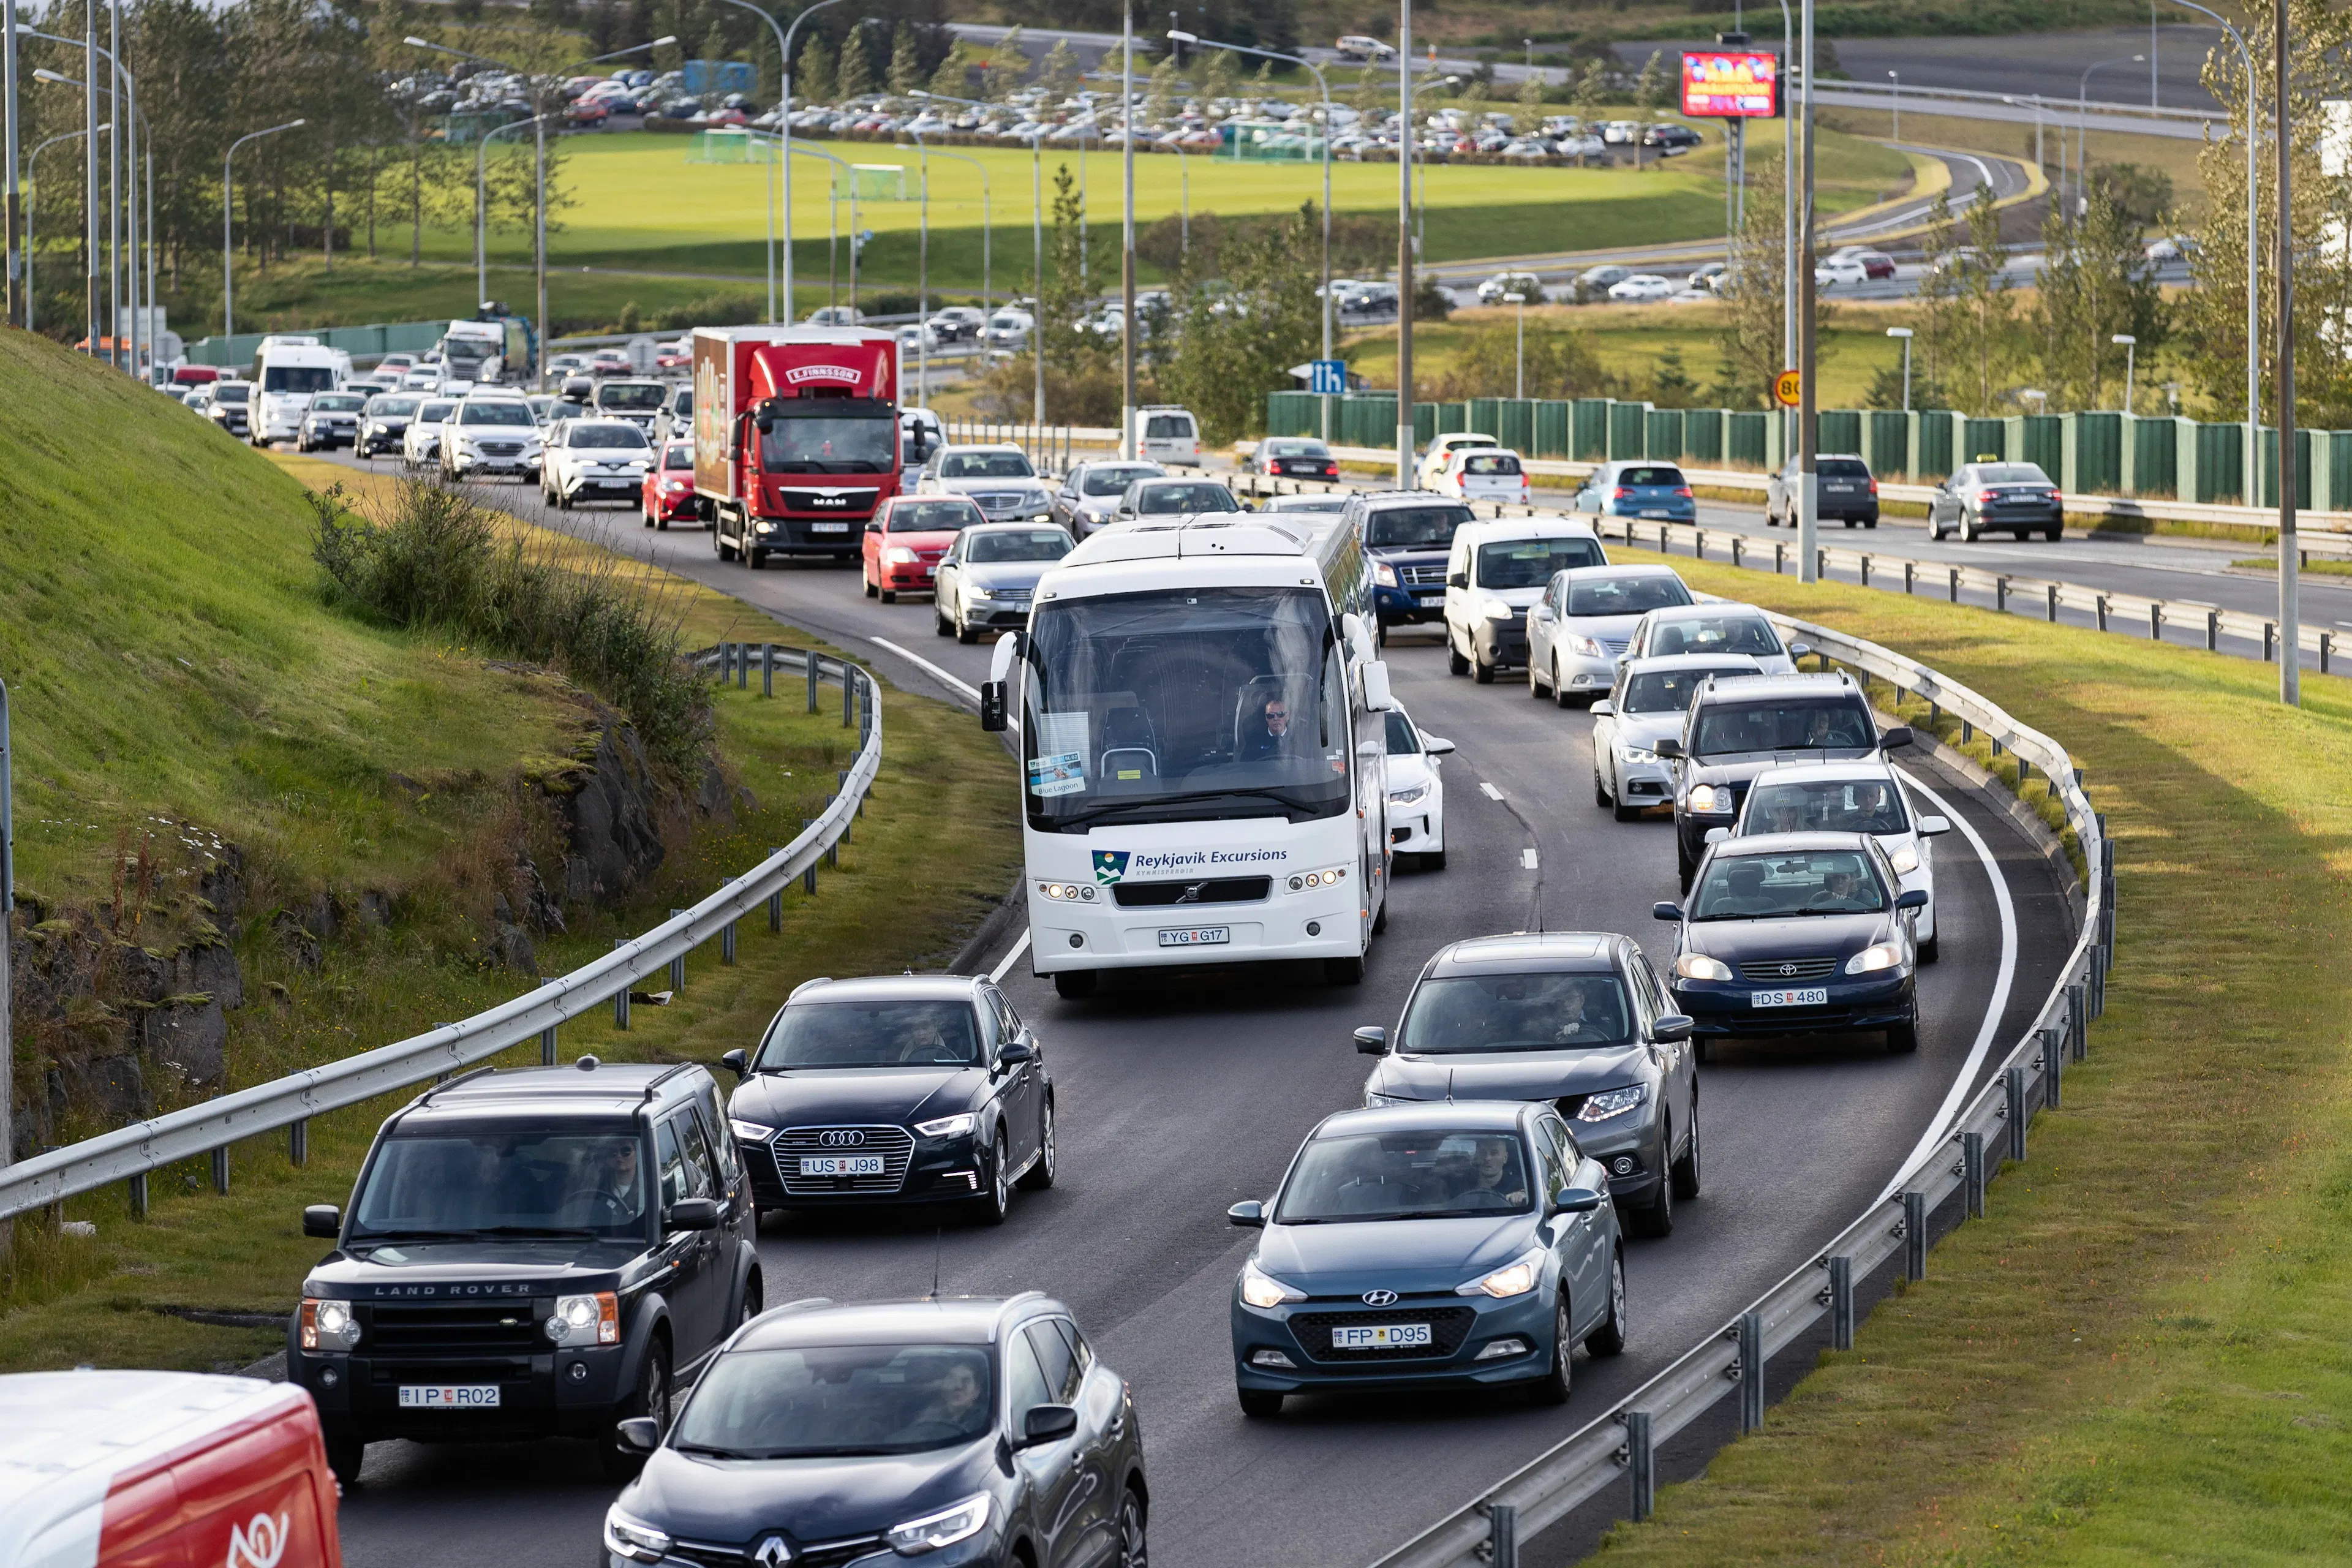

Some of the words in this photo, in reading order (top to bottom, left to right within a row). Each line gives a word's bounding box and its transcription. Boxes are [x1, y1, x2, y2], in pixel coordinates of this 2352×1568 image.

[1054, 783, 1078, 792] Lagoon
[1136, 852, 1206, 869] Reykjavik
[1210, 849, 1287, 862] Excursions
[1170, 932, 1189, 942] YG
[1200, 930, 1223, 941] G17
[1761, 993, 1784, 1005] DS
[1797, 990, 1825, 1003] 480
[813, 1159, 835, 1172] US
[850, 1159, 879, 1172] J98
[375, 1287, 435, 1295] LAND
[450, 1284, 529, 1294] ROVER
[1348, 1329, 1373, 1344] FP
[1390, 1327, 1427, 1343] D95
[415, 1389, 439, 1403] IP
[458, 1389, 496, 1403] R02
